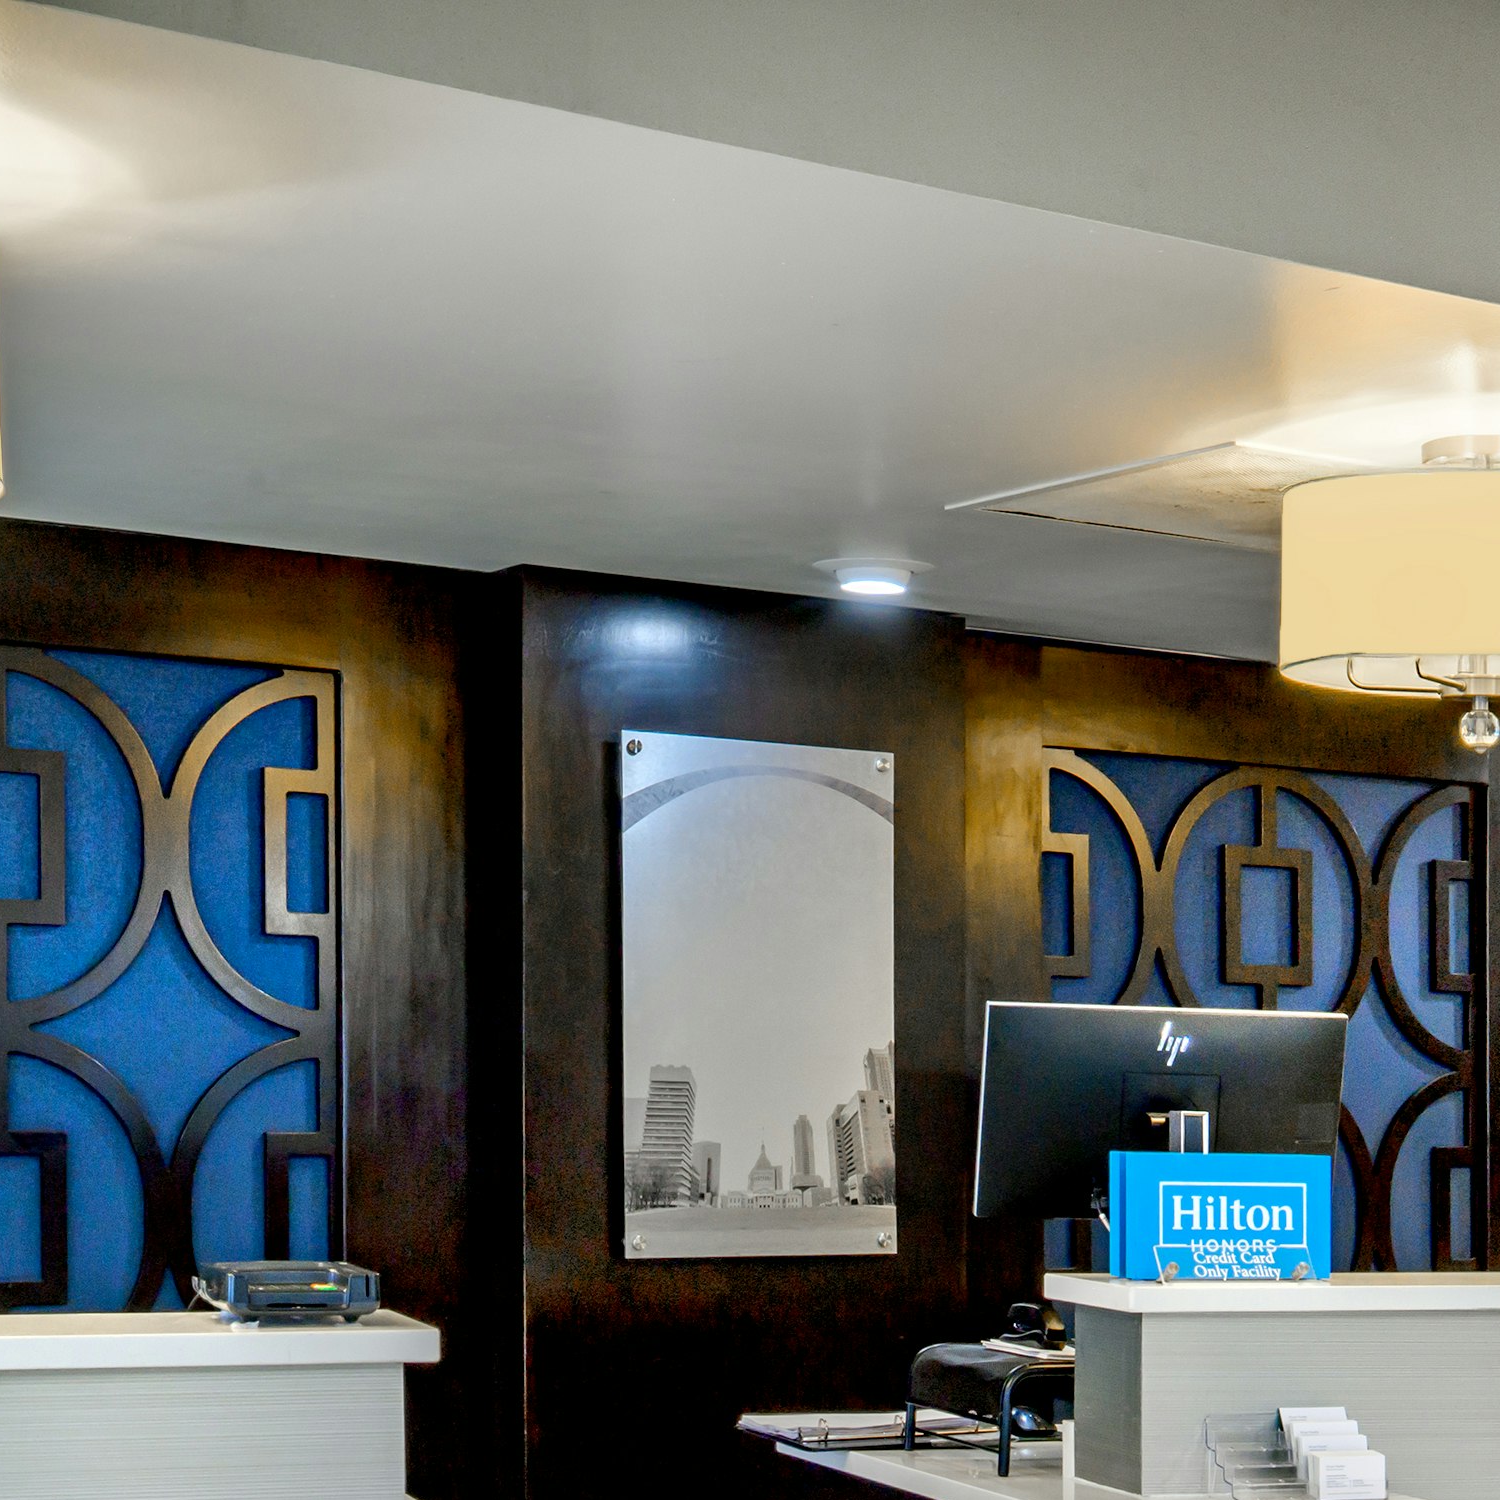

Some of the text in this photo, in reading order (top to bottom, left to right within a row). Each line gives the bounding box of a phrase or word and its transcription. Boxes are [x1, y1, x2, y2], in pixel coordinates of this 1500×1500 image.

[1156, 1020, 1191, 1067] hp
[1172, 1195, 1295, 1231] Hilton
[1190, 1239, 1278, 1252] HONORS
[1193, 1251, 1275, 1264] Credit Card
[1194, 1265, 1282, 1281] Only Facility
